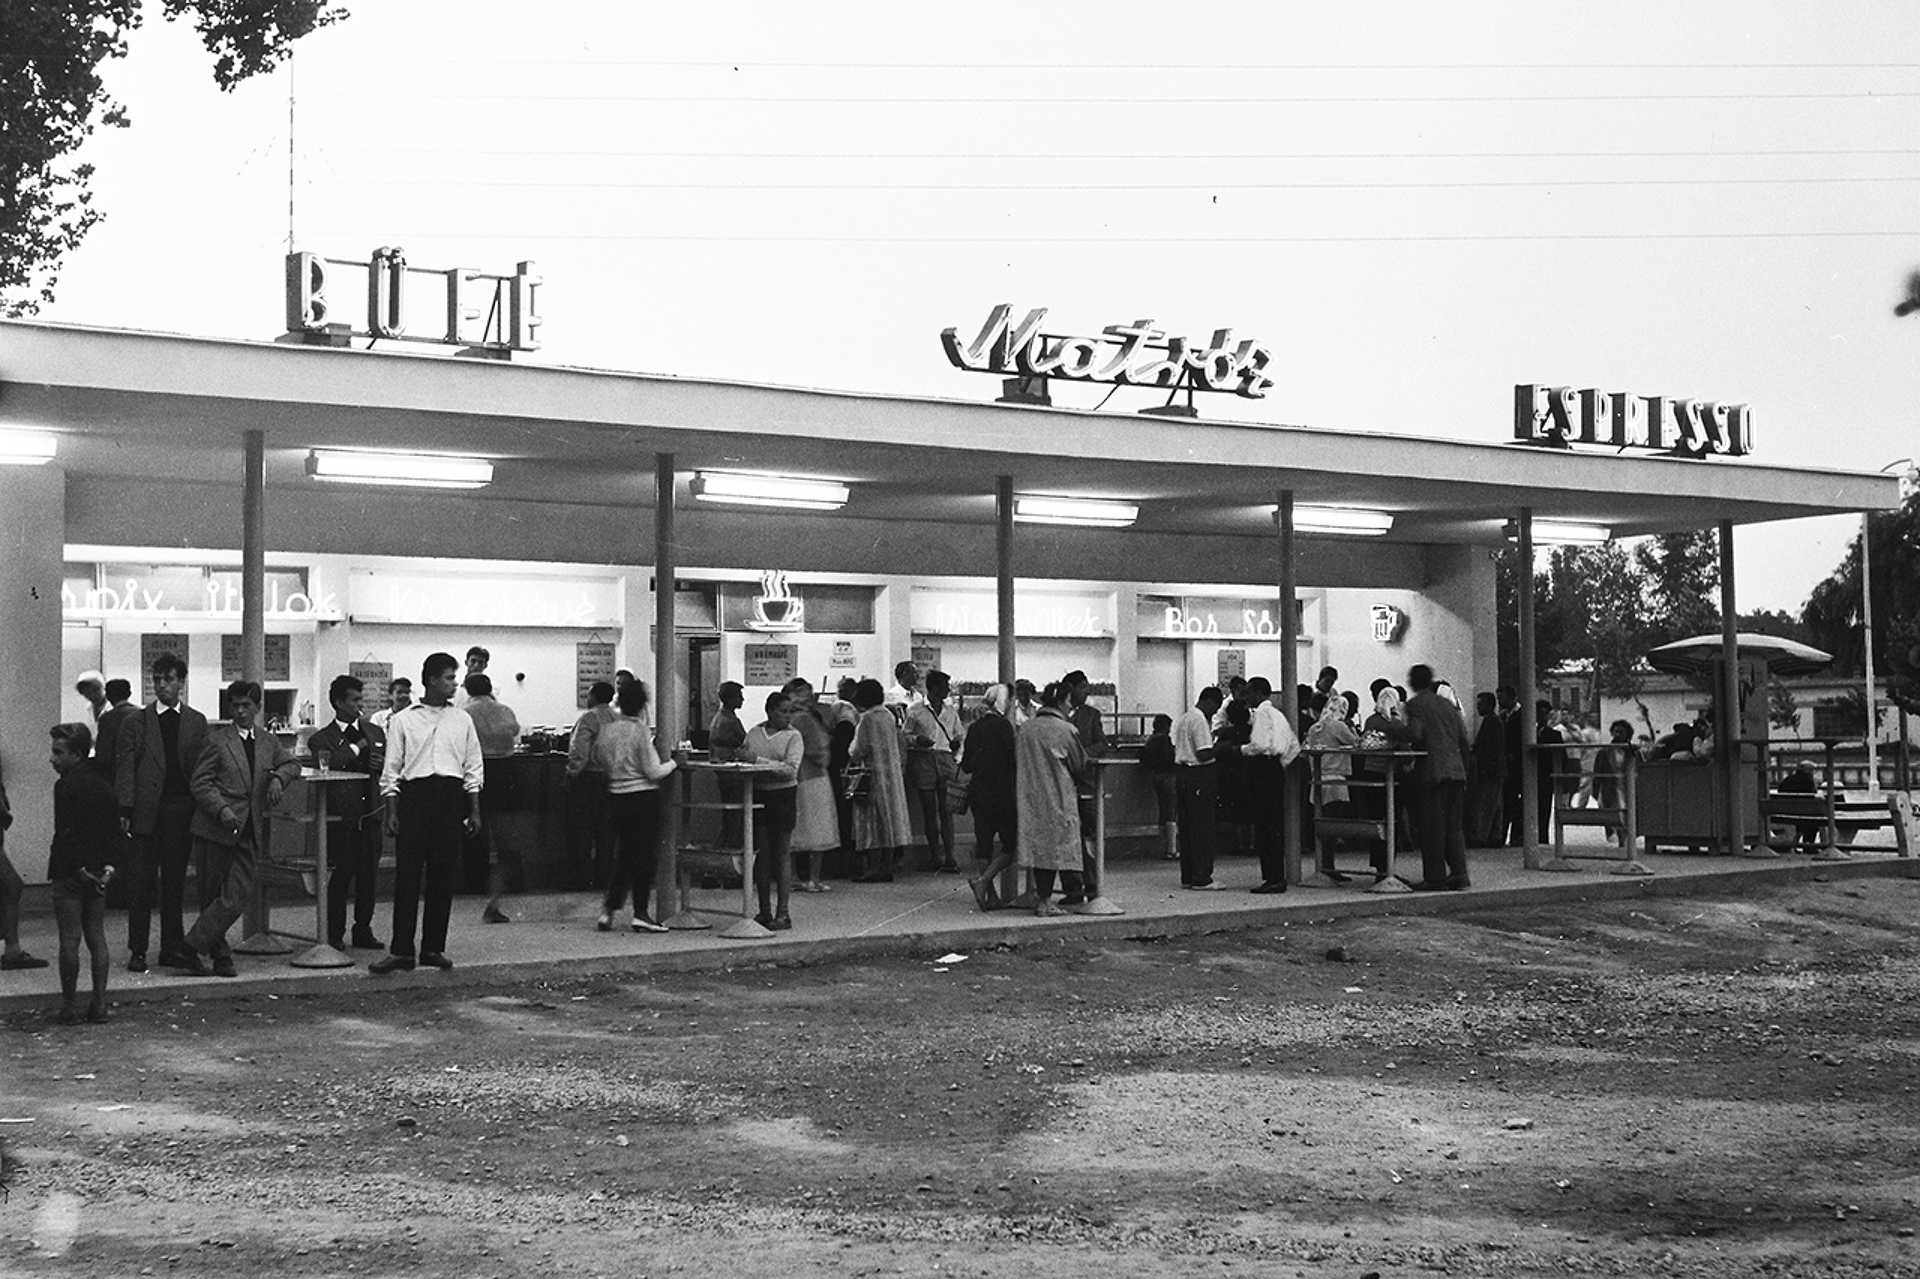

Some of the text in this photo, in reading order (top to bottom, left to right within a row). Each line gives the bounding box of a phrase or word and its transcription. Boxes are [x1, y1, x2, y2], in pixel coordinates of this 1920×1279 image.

[286, 246, 542, 350] BÜFÉ
[940, 303, 1274, 399] Matróz
[1515, 384, 1757, 456] ESPRESSO
[207, 579, 341, 617] itlok
